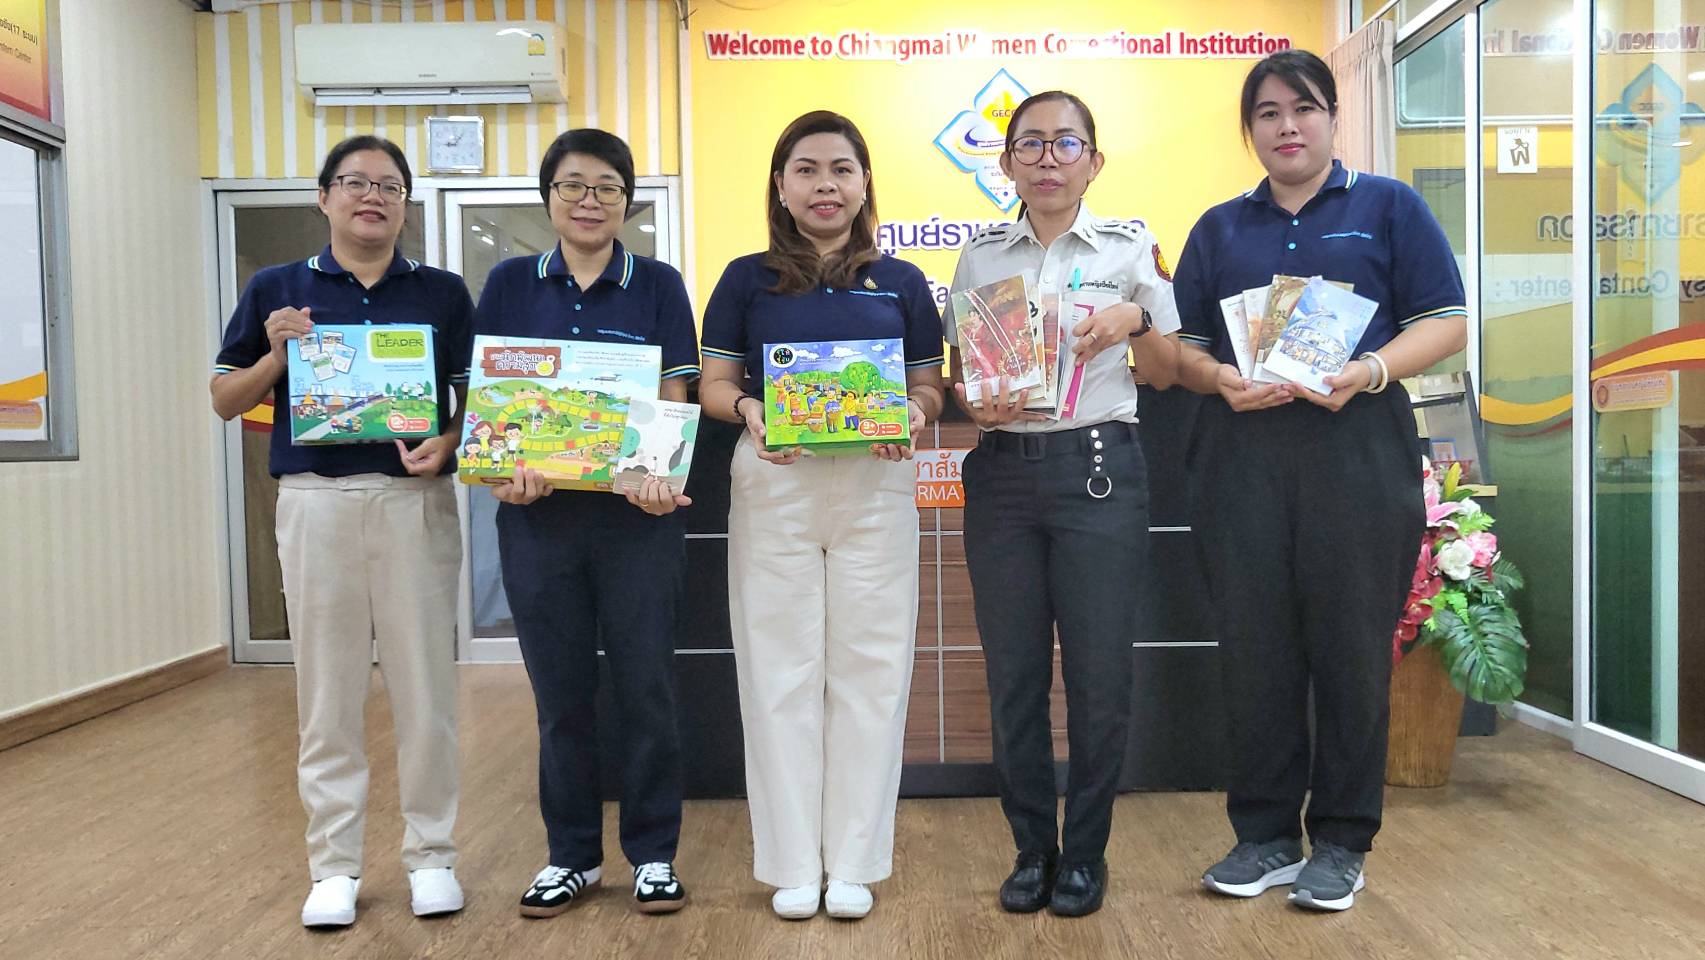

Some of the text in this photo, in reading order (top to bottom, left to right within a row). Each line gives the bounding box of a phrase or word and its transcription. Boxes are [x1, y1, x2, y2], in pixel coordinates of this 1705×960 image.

[708, 31, 1291, 61] Welcome to Chingmai Wmen Coeional Institution
[376, 338, 425, 348] LEADER
[917, 484, 964, 501] RMA
